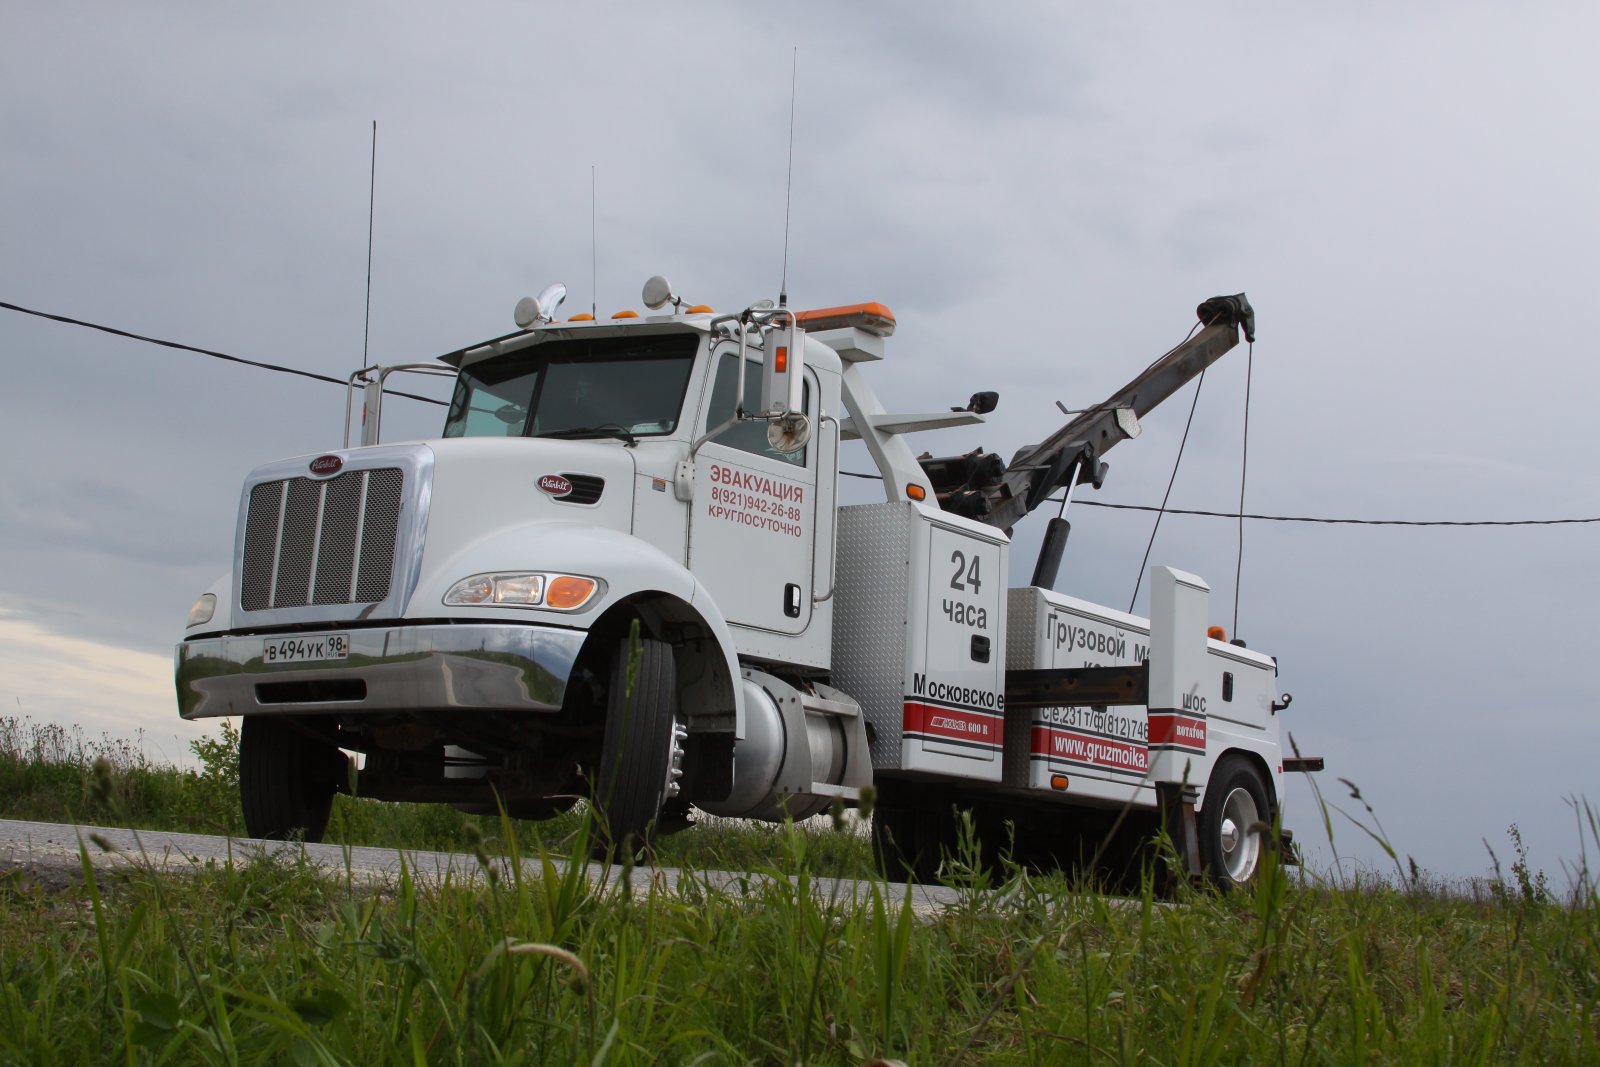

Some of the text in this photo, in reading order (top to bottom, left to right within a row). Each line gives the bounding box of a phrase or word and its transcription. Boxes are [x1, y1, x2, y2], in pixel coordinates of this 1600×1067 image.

[541, 477, 569, 491] Peterbilt
[710, 464, 803, 504] ЭВАКУАЦИЯ
[711, 486, 801, 521] 8(921)942-26-88
[708, 504, 802, 538] КРУГЛОСУТОЧНО
[950, 550, 981, 595] 24
[942, 598, 987, 630] часа
[328, 637, 343, 652] 98
[1047, 612, 1126, 660] Грузовой
[913, 672, 1004, 710] Московское
[1182, 692, 1207, 713] шос
[968, 722, 981, 734] 600
[1176, 724, 1205, 740] ROTATOR
[1055, 736, 1148, 769] www.gruzmoika.
